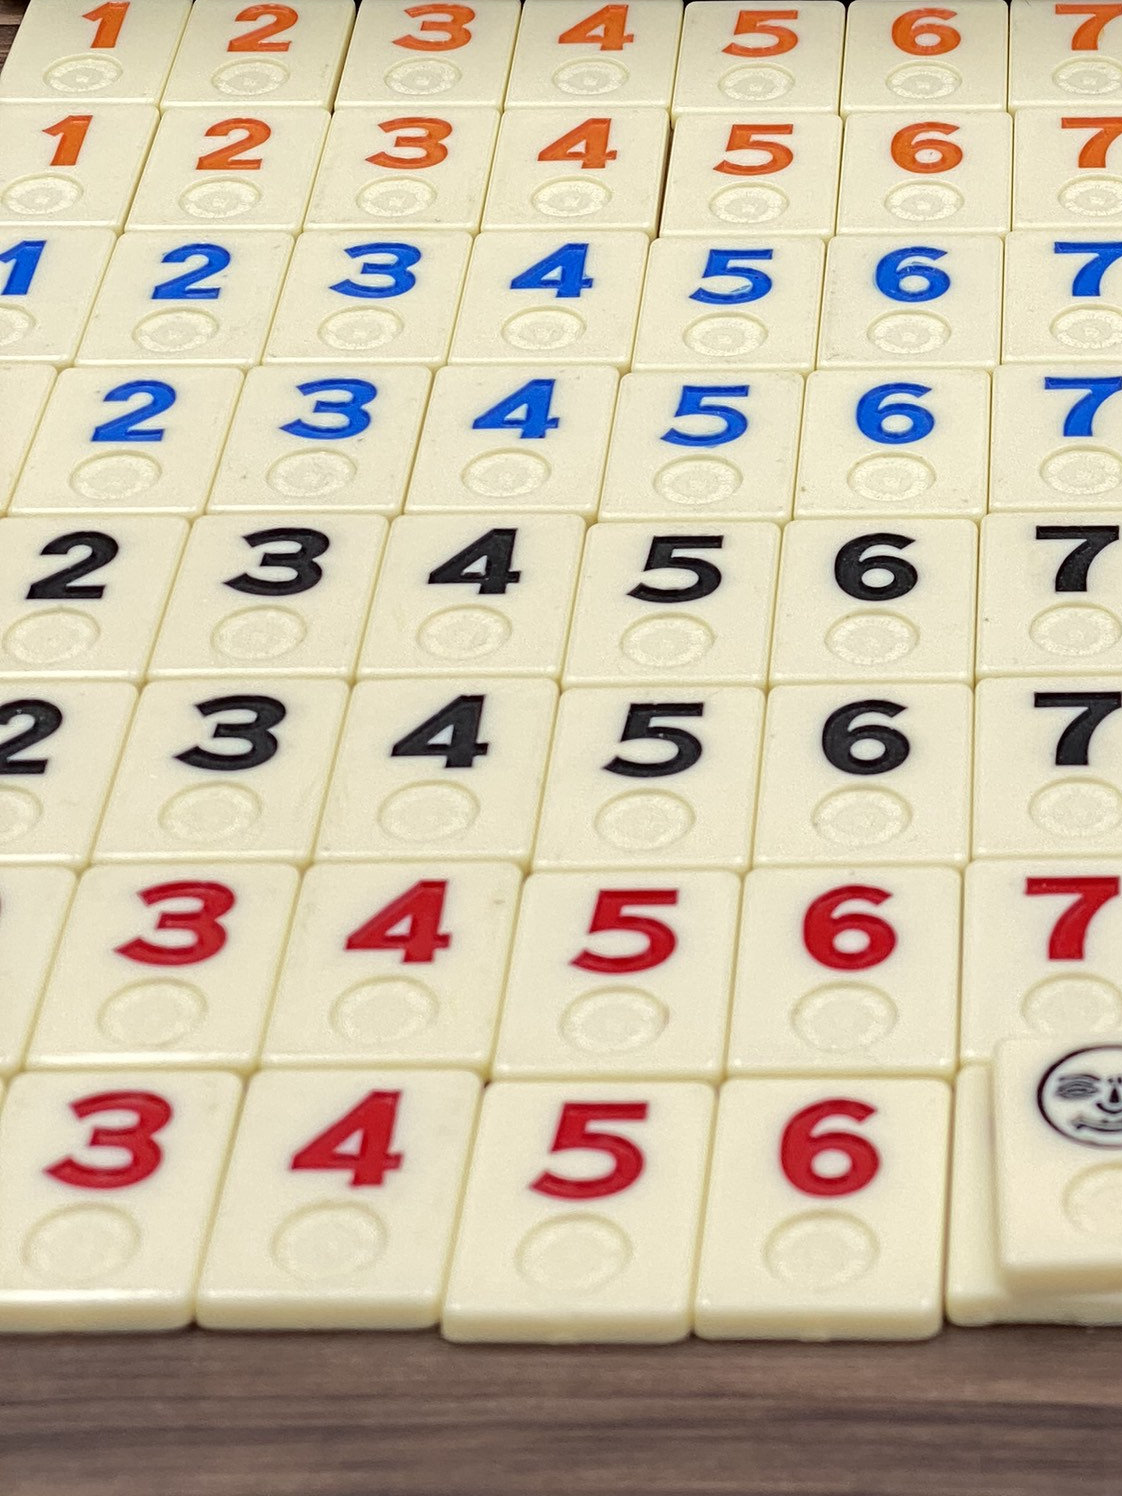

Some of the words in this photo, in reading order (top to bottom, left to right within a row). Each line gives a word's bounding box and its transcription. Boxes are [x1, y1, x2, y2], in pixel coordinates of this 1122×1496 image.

[83, 2, 130, 48] 1
[227, 4, 298, 52] 2
[393, 3, 475, 51] 3
[558, 4, 634, 51] 4
[722, 10, 799, 58] 5
[891, 8, 961, 56] 6
[43, 115, 92, 166] 1
[196, 118, 271, 170] 2
[366, 117, 452, 169] 3
[538, 118, 617, 169] 4
[713, 124, 793, 176] 5
[891, 122, 963, 174] 6
[0, 241, 45, 295] 1
[152, 244, 230, 299] 2
[330, 243, 421, 298] 3
[511, 244, 592, 298] 4
[690, 249, 772, 304] 5
[875, 247, 950, 302] 6
[92, 381, 176, 441] 2
[282, 379, 377, 439] 3
[473, 379, 558, 438] 4
[661, 386, 748, 447] 5
[856, 383, 934, 444] 6
[1045, 376, 1122, 436] 7
[26, 531, 119, 599] 2
[224, 528, 330, 596] 3
[428, 529, 521, 594] 4
[627, 536, 723, 603] 5
[834, 533, 918, 601] 6
[1036, 526, 1119, 592] 7
[0, 700, 63, 775] 2
[174, 695, 286, 771] 3
[391, 695, 489, 768] 4
[604, 703, 703, 778] 5
[822, 700, 910, 775] 6
[1034, 692, 1122, 765] 7
[117, 881, 235, 966] 3
[346, 881, 450, 963] 4
[572, 890, 677, 974] 5
[803, 885, 896, 971] 6
[1026, 877, 1120, 960] 7
[46, 1092, 172, 1189] 3
[291, 1091, 402, 1187] 4
[532, 1103, 647, 1200] 5
[780, 1099, 880, 1197] 6
